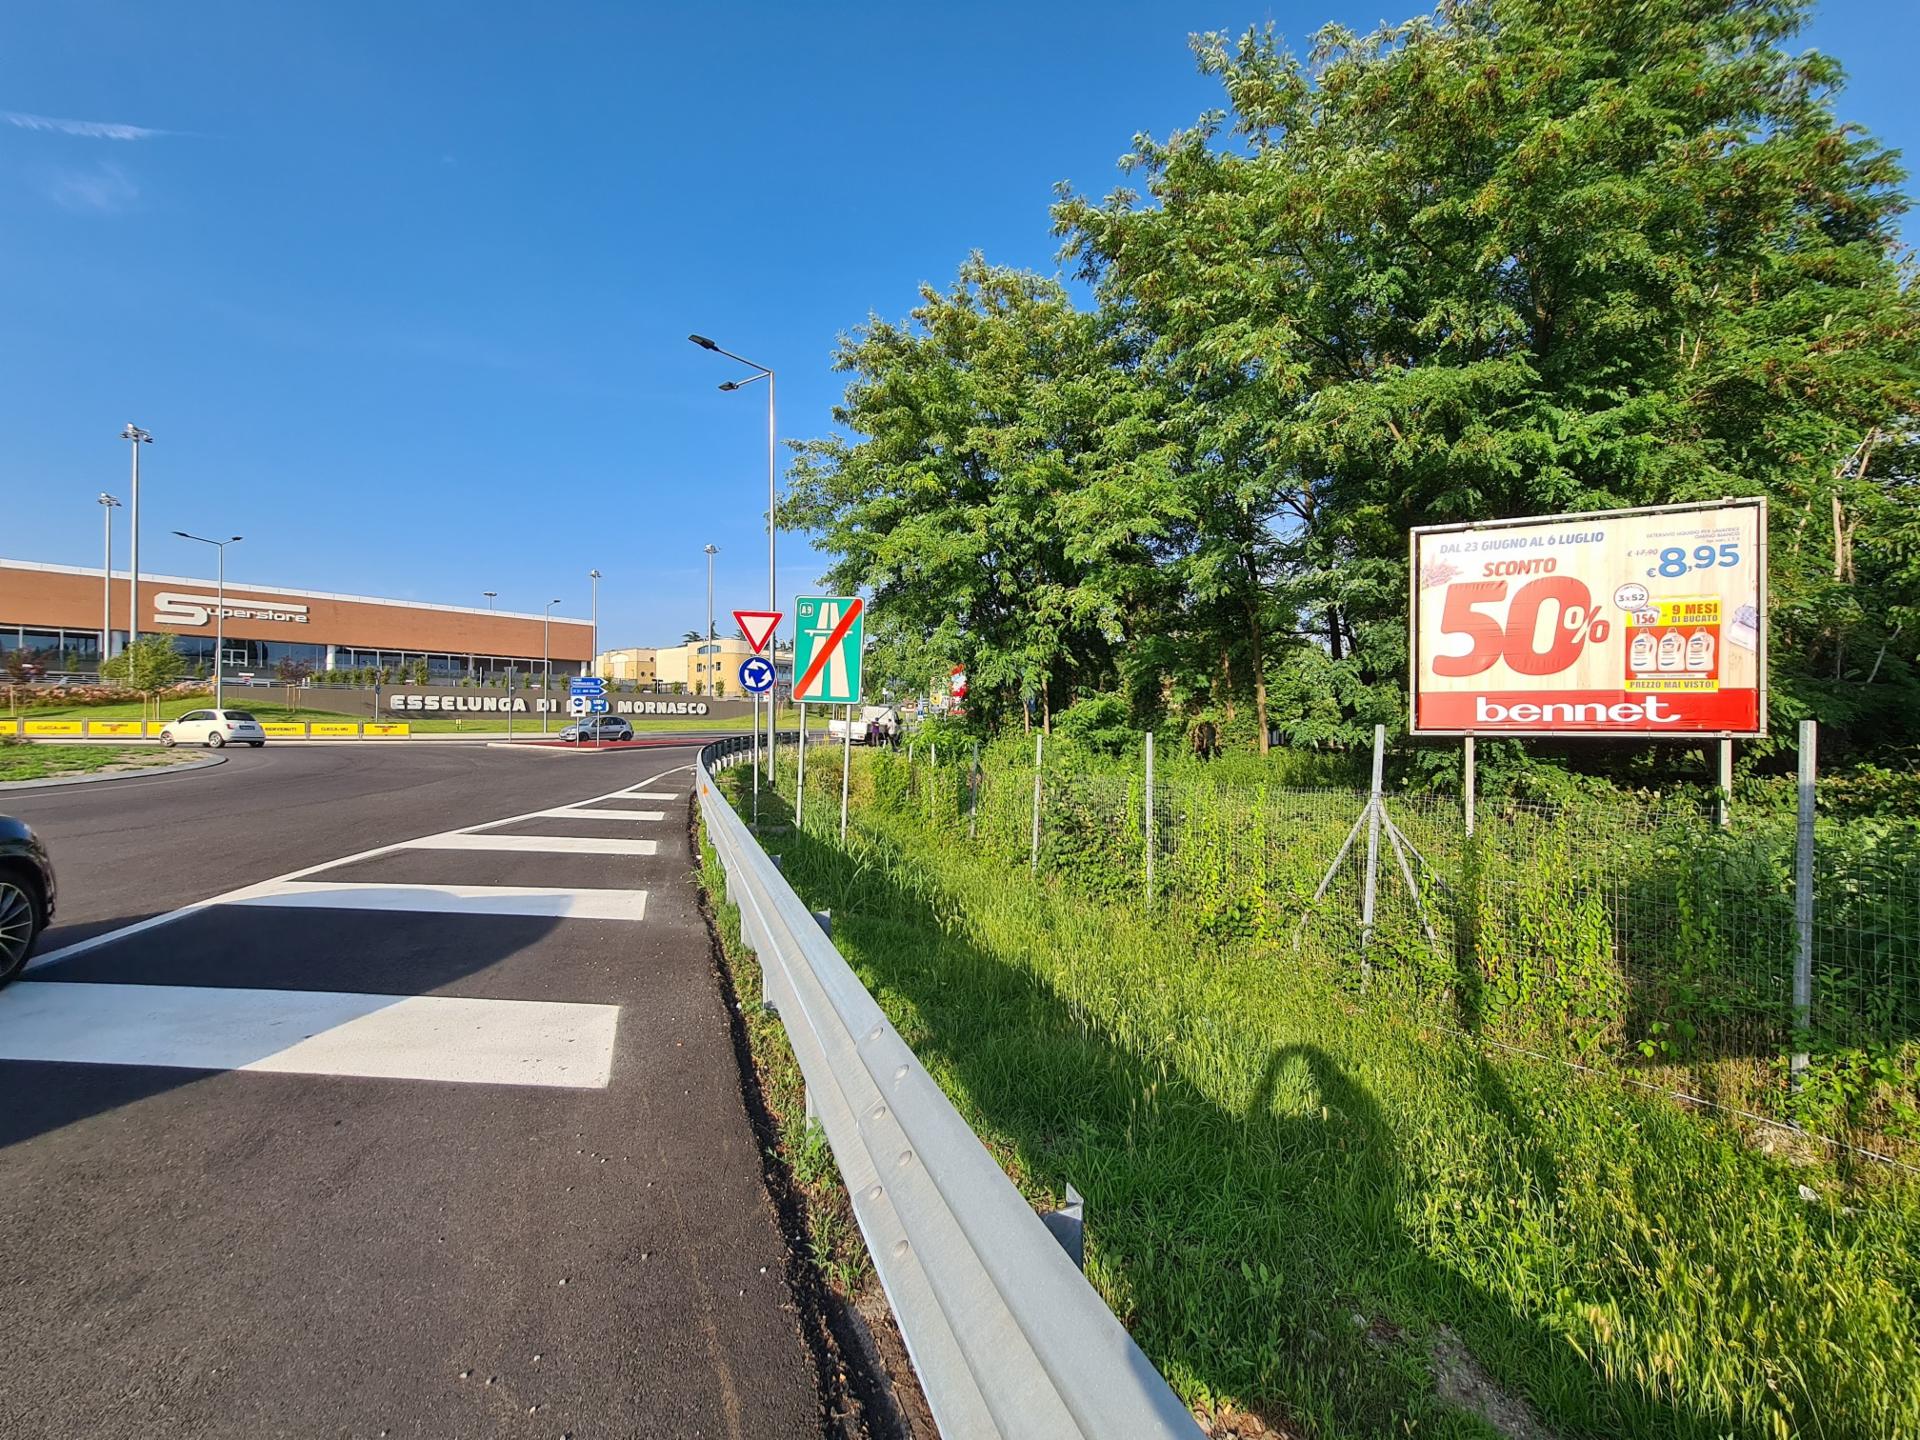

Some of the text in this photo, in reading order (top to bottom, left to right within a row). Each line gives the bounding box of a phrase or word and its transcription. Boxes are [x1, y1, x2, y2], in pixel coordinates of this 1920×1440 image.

[1440, 531, 1605, 554] DAL 23 GIUGNO AL 6 LUGLIO
[1483, 557, 1557, 578] SCONTO
[1646, 543, 1740, 578] € 8,95
[153, 591, 308, 626] Superstore
[801, 605, 812, 614] A9
[1635, 613, 1656, 624] 156
[1672, 603, 1718, 614] 9 MESI
[1431, 575, 1611, 677] 50%
[1671, 615, 1718, 623] DI BUCATO
[1684, 680, 1714, 688] VISTO!
[390, 695, 527, 712] ESSELUNGA
[536, 698, 557, 712] DI
[617, 700, 708, 715] MORNASCO
[1476, 695, 1682, 723] bennet
